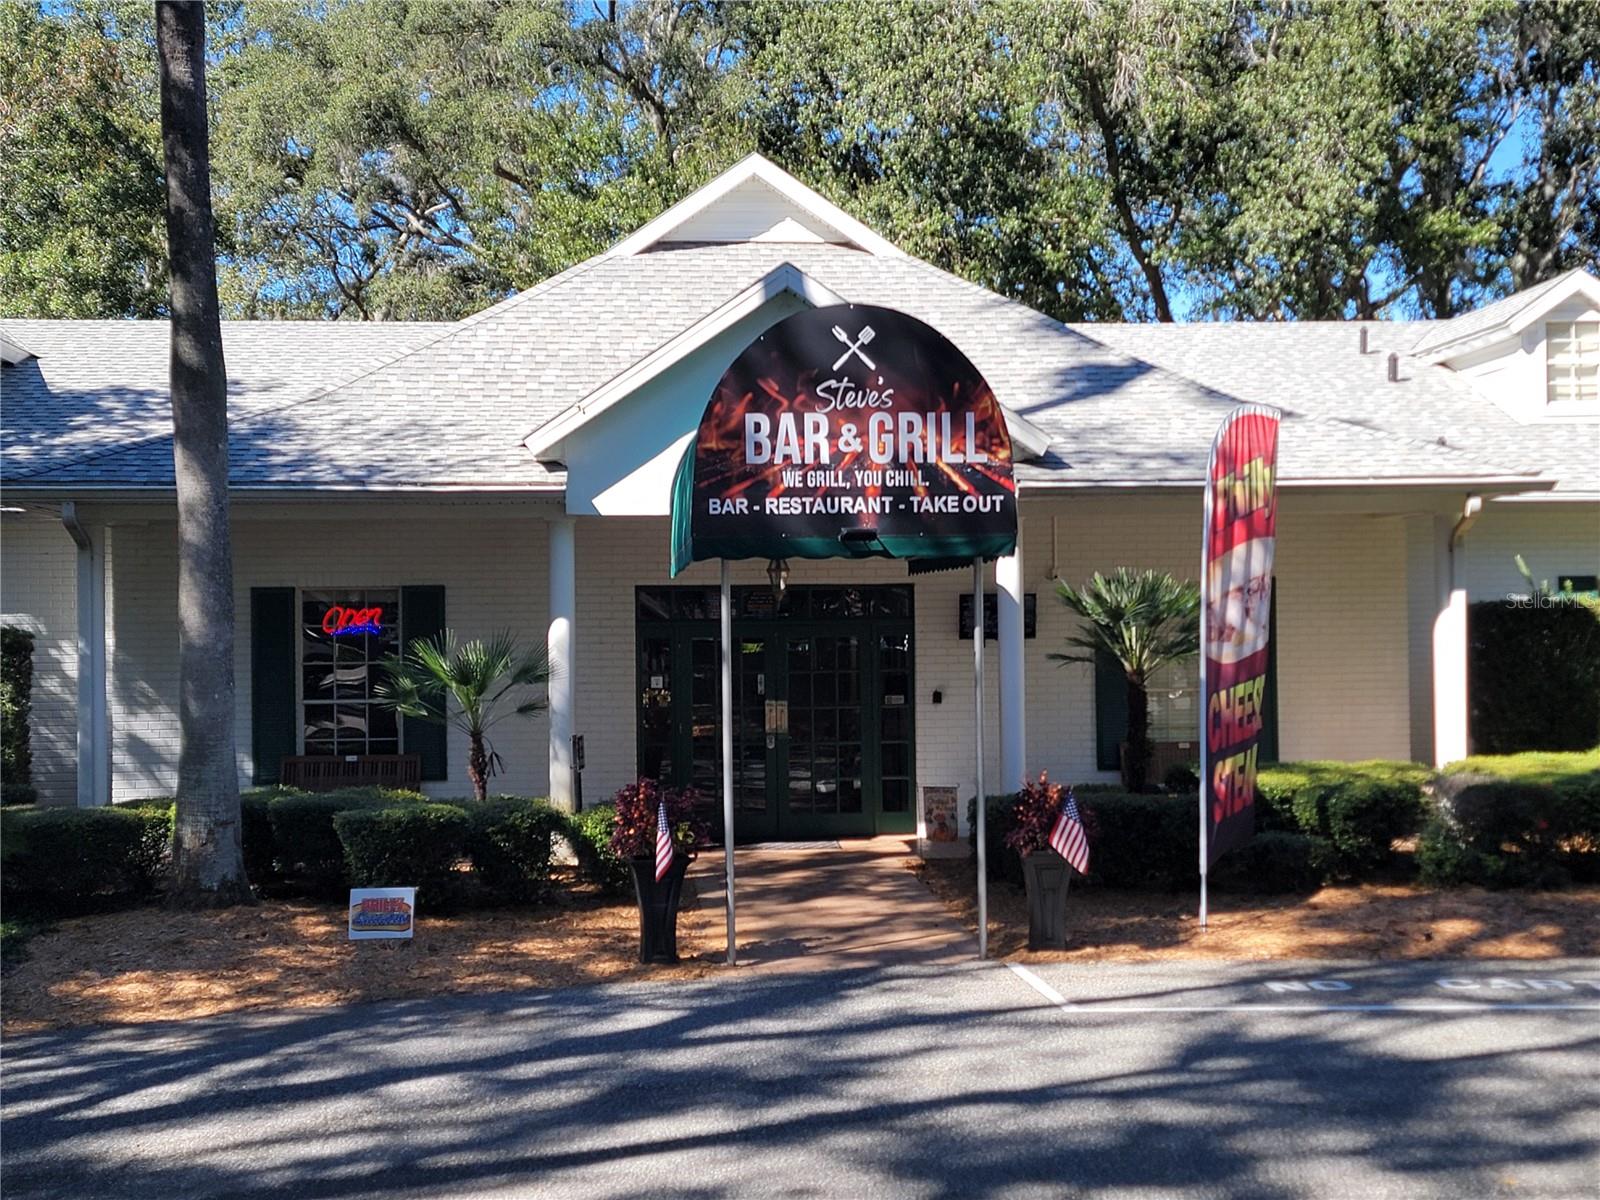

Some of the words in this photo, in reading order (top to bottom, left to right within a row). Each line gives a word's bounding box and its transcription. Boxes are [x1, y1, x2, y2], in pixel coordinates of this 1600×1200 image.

[815, 375, 895, 413] Steve's
[745, 411, 830, 465] BAR
[838, 423, 864, 453] &
[868, 411, 988, 465] GRILL
[782, 470, 804, 488] WE
[807, 470, 851, 490] GRILL,
[854, 470, 882, 487] YOU
[885, 469, 930, 487] CHILL.
[708, 497, 749, 515] BAR
[765, 495, 894, 515] RESTAURANT
[909, 494, 960, 514] TAKE
[962, 494, 1005, 513] OUT
[321, 605, 383, 635] Open
[1264, 980, 1352, 992] NO
